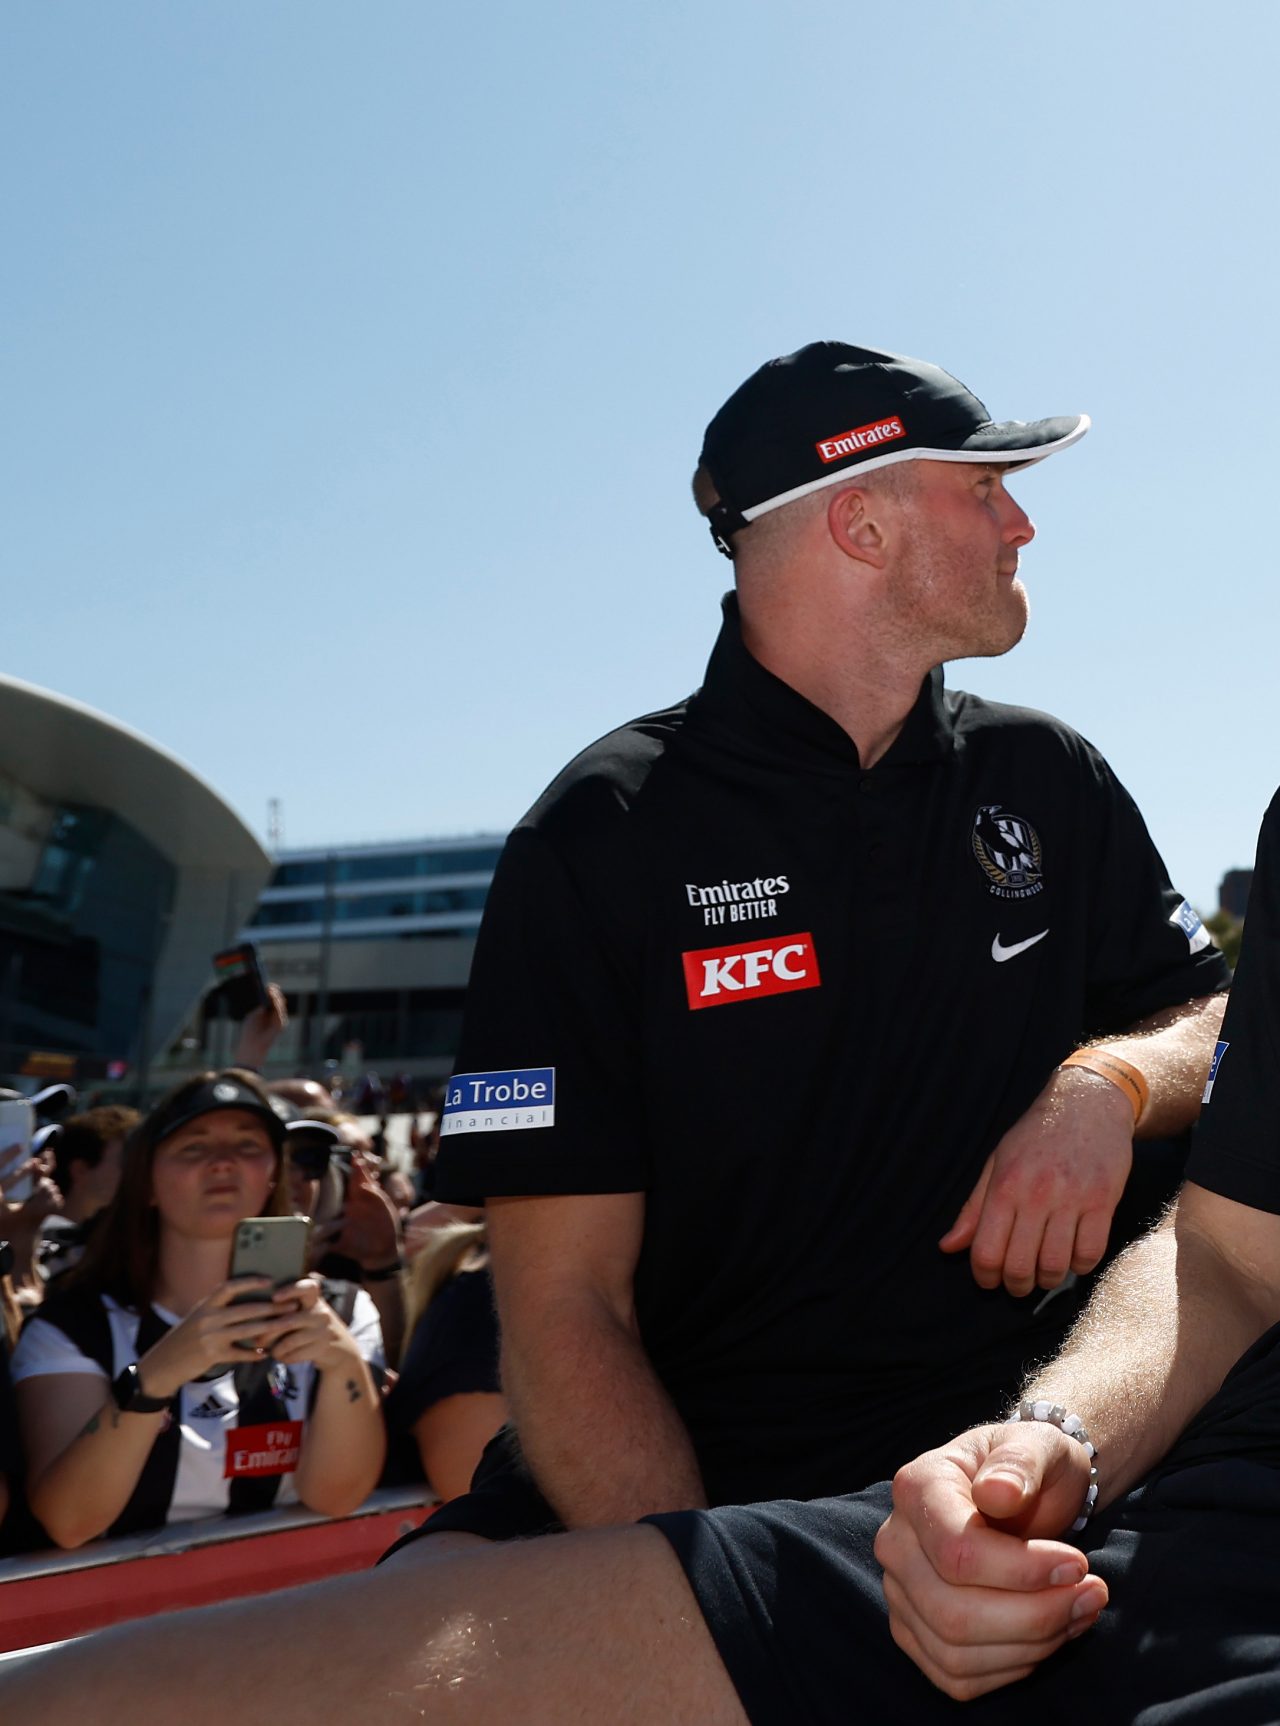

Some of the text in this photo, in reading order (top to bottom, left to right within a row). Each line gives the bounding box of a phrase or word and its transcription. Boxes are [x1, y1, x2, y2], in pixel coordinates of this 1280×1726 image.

[820, 421, 901, 459] Emirates
[685, 875, 790, 906] Emirates
[703, 898, 778, 926] FLY BETTER
[700, 943, 807, 997] KFC
[444, 1078, 548, 1108] La Trobe
